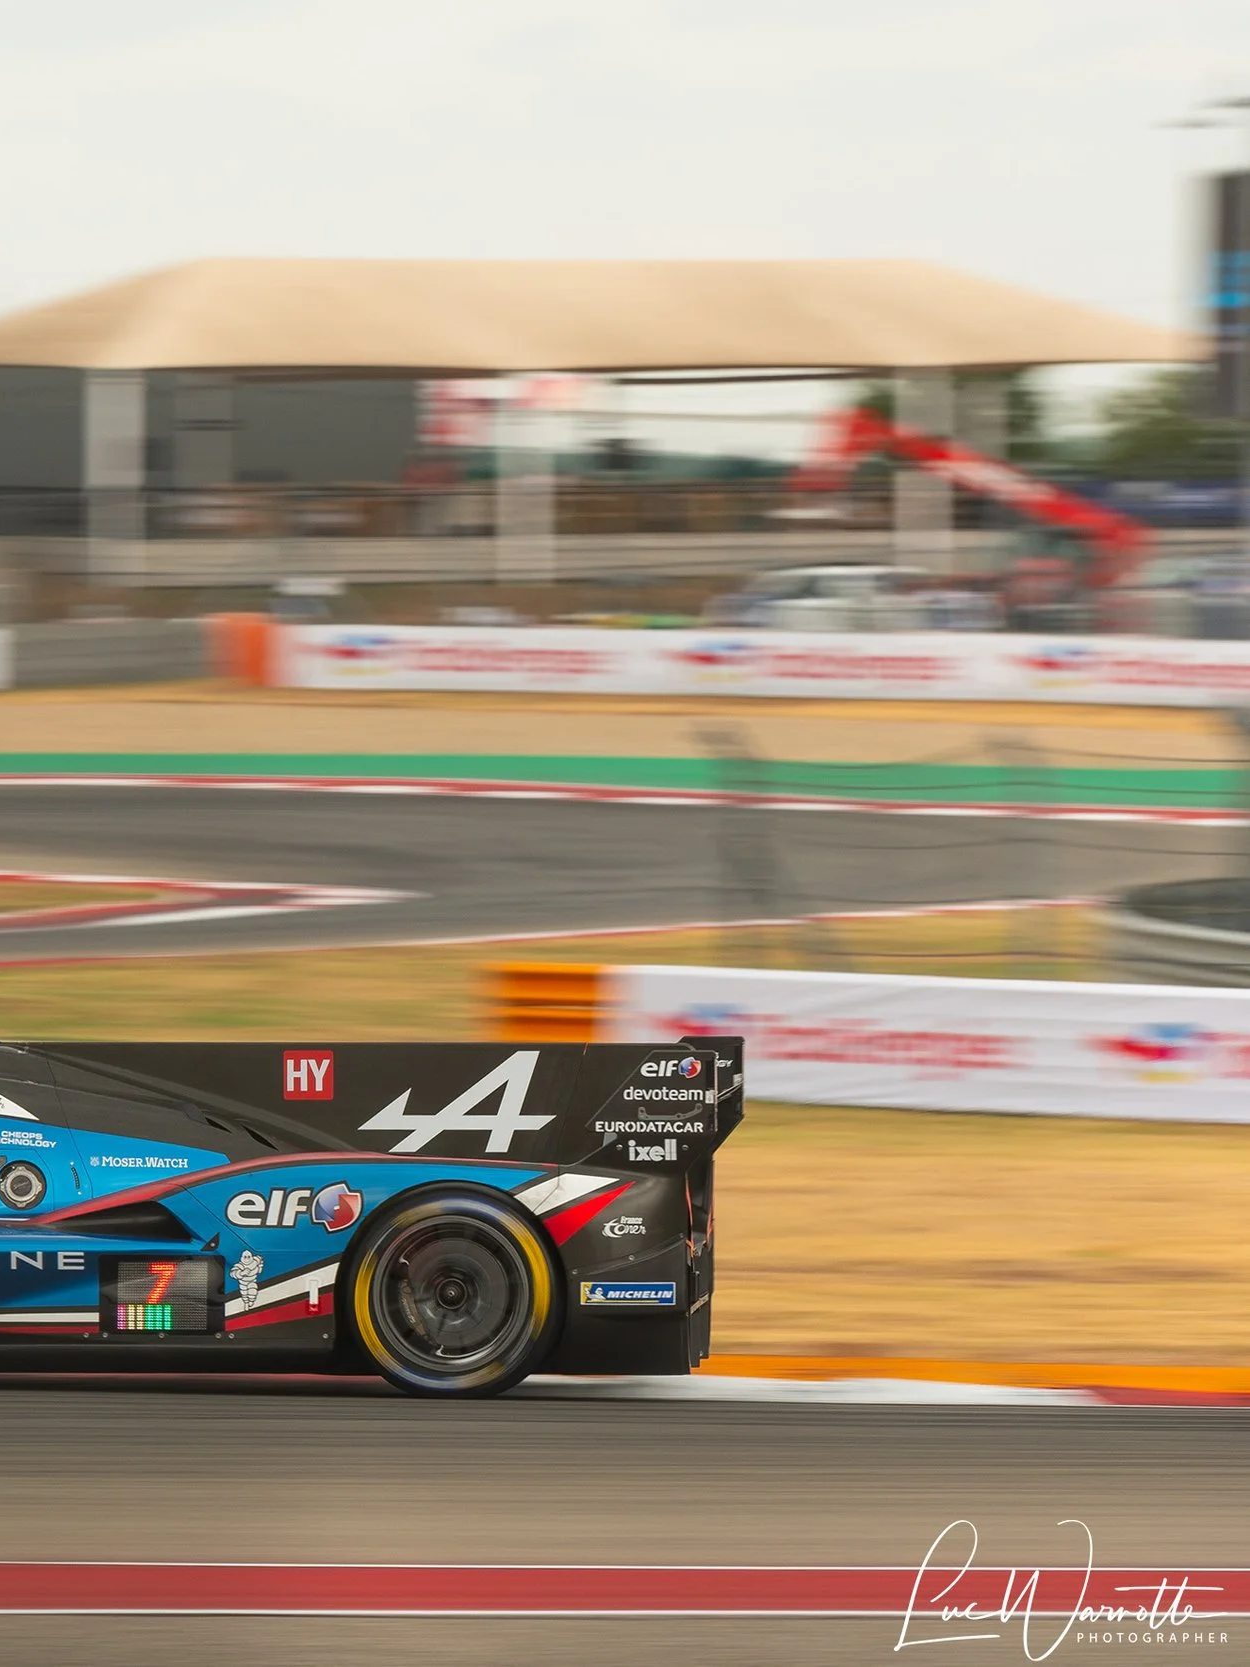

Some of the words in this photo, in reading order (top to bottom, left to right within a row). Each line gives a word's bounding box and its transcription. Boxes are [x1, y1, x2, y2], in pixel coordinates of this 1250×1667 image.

[286, 1059, 331, 1092] HY
[640, 1059, 679, 1078] elf
[623, 1086, 704, 1101] devoteam
[1, 1130, 44, 1140] CHEOPS
[595, 1120, 704, 1133] EURODATACAR
[628, 1138, 678, 1162] ixell
[101, 1155, 189, 1169] MOSER.WATCH
[227, 1189, 311, 1227] elf
[147, 1261, 178, 1304] 7
[607, 1290, 674, 1299] MICHELIN
